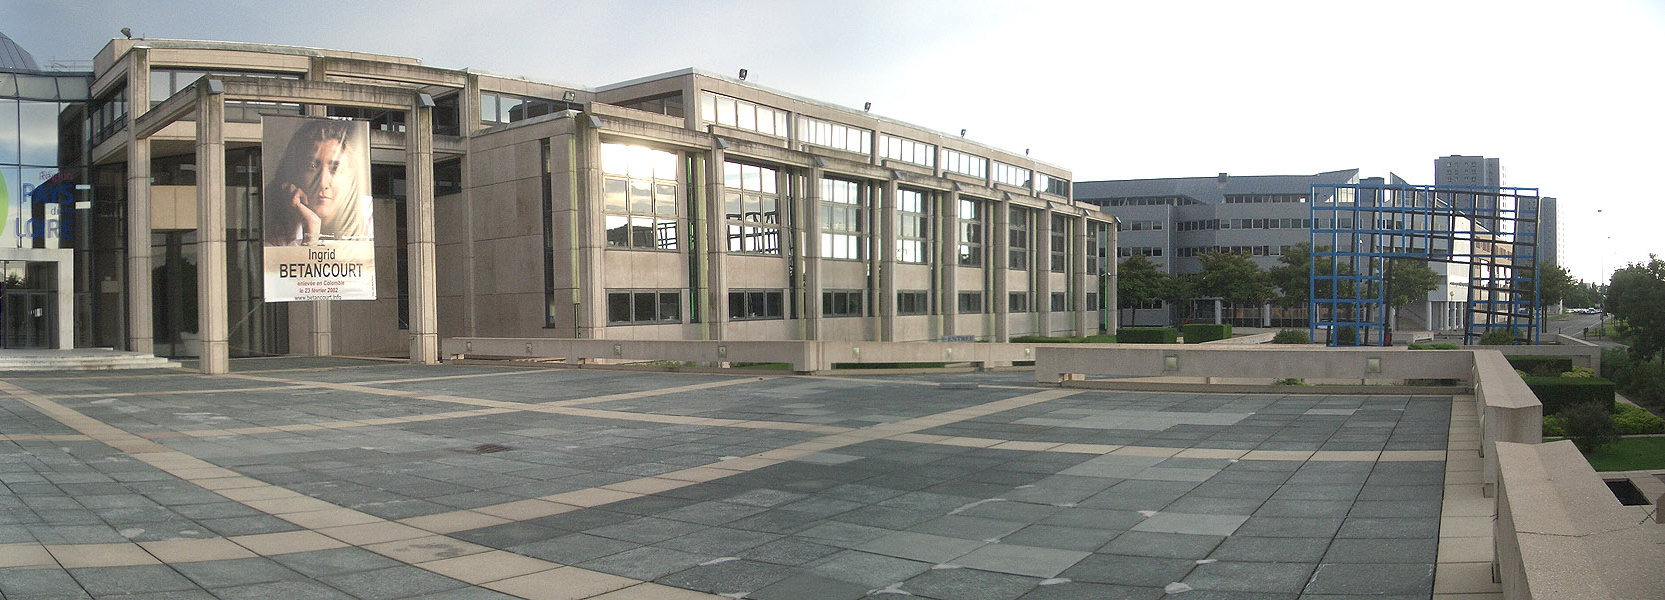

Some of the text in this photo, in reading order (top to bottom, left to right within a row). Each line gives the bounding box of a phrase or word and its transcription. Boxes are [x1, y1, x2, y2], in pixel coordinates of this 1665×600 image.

[22, 183, 74, 204] PAYS
[15, 217, 74, 239] LOIRE
[308, 248, 336, 263] Ingrid
[279, 263, 363, 278] BETANCOURT
